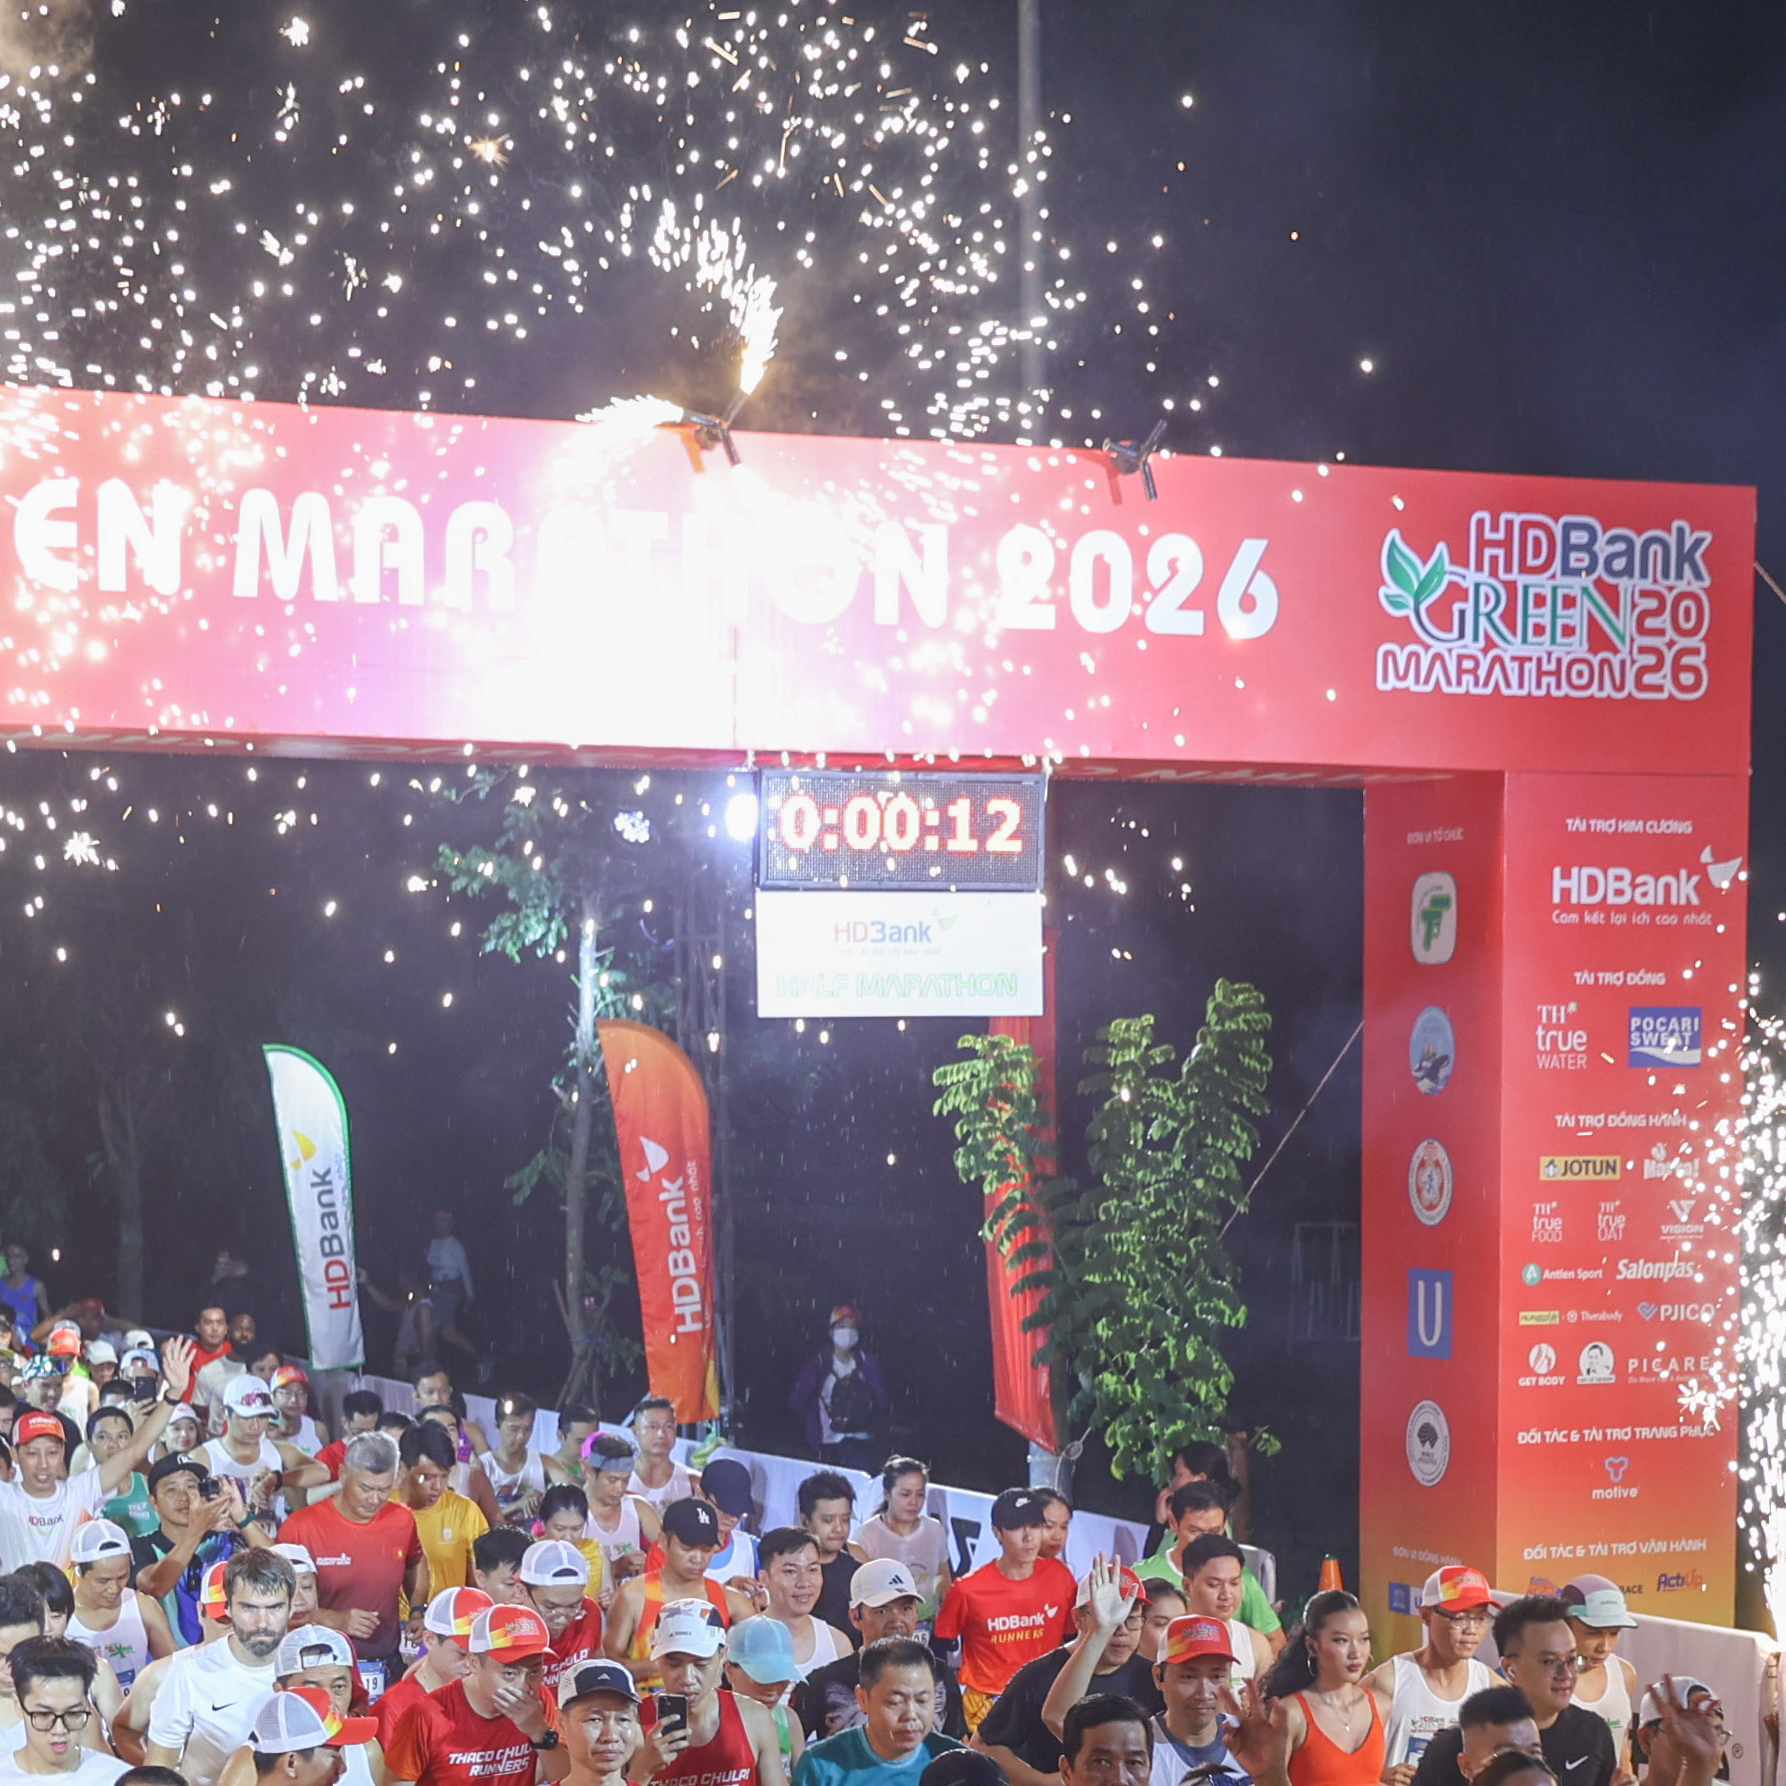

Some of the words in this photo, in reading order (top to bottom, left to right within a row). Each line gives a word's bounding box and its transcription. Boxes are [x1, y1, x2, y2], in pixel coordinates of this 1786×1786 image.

[1472, 512, 1711, 583] HDBank
[996, 523, 1281, 640] 2026
[1413, 567, 1629, 648] GREEN
[1634, 588, 1707, 640] 20
[1379, 648, 1628, 693] MARATHON
[1633, 645, 1707, 695] 26
[780, 794, 1024, 853] 0:00:12
[1565, 816, 1587, 833] TÀI
[1618, 819, 1643, 833] KIM
[1551, 865, 1701, 906] HDBank
[1551, 909, 1580, 925] Cam
[1655, 913, 1678, 925] cao
[1536, 1004, 1566, 1025] TH
[1630, 1016, 1700, 1032] POCARI
[1535, 1025, 1588, 1052] true
[1629, 1032, 1693, 1047] SWEAT
[1536, 1053, 1588, 1070] WATER
[1560, 1158, 1618, 1177] JOTUN
[1532, 1216, 1563, 1231] true
[1597, 1212, 1626, 1228] true
[310, 1166, 352, 1310] HDBank
[1531, 1230, 1563, 1243] FOOD
[658, 1175, 703, 1334] HDBank
[1576, 1267, 1604, 1282] Sport
[1615, 1258, 1695, 1284] Salonpas
[1580, 1310, 1623, 1323] Therabody
[1659, 1303, 1716, 1321] PJICO
[1627, 1355, 1711, 1374] PICARE
[1518, 1376, 1538, 1387] GET
[1538, 1375, 1565, 1386] BODY
[1570, 1430, 1581, 1442] &
[1634, 1426, 1678, 1439] TRANG
[1591, 1486, 1638, 1500] motive
[1575, 1545, 1585, 1558] &
[987, 1612, 1045, 1632] HDBank
[990, 1628, 1044, 1644] RUNNERS
[448, 1749, 494, 1766] THACO
[469, 1755, 529, 1779] RUNNERS
[700, 1767, 751, 1786] CHULAI
